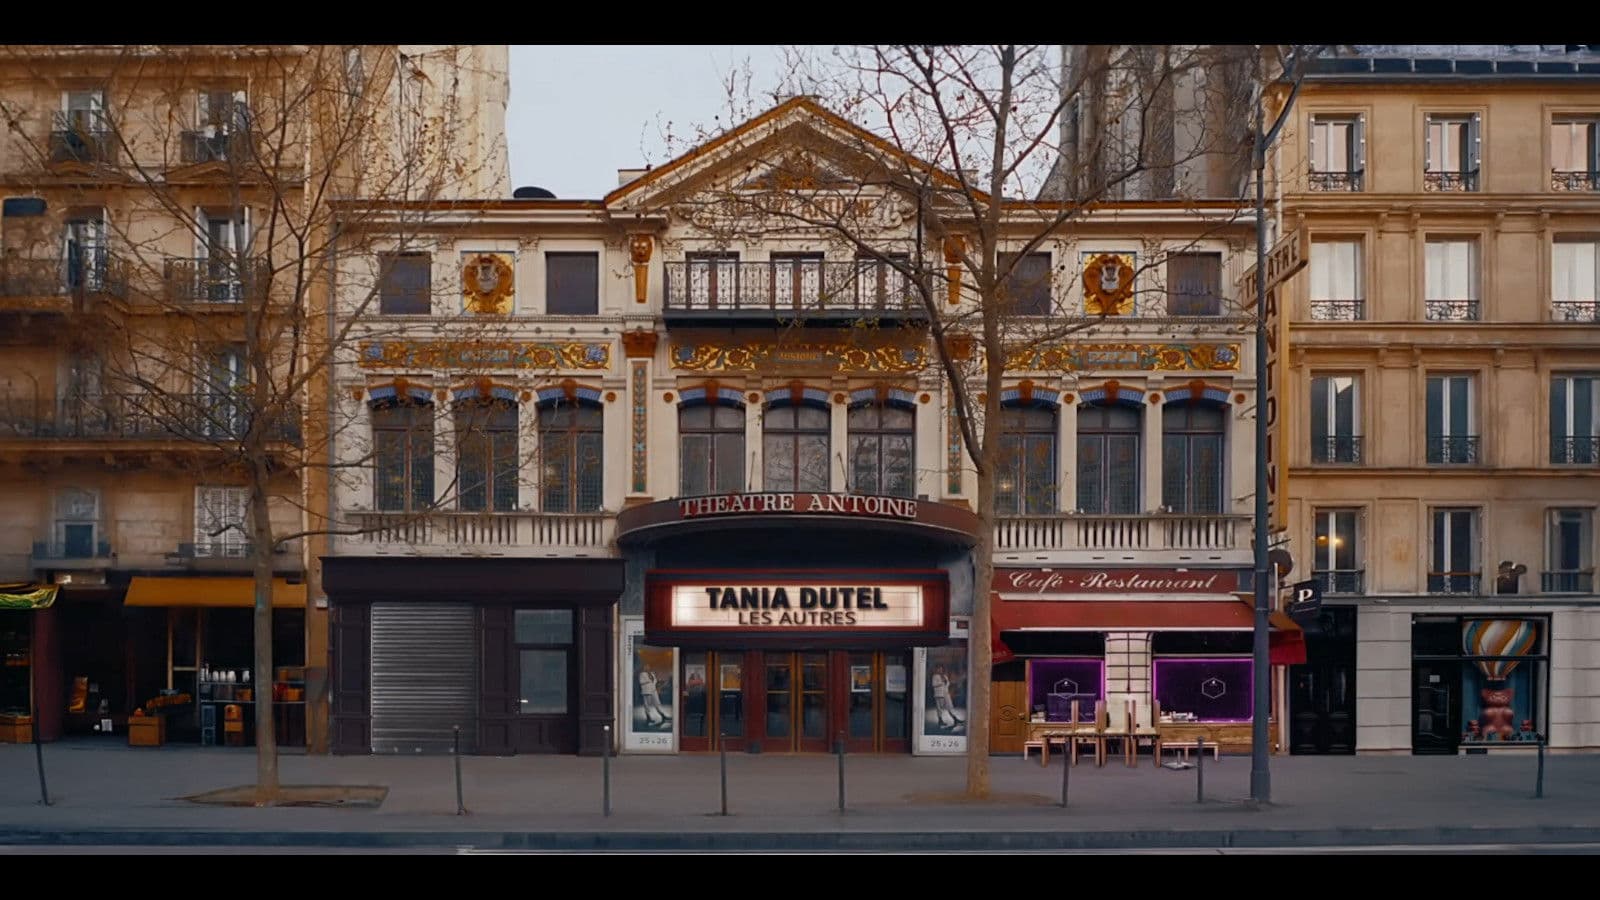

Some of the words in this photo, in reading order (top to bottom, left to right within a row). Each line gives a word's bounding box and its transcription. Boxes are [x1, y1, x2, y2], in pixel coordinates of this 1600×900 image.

[679, 493, 795, 516] THEATRE
[808, 493, 918, 518] ANTOINE
[1009, 571, 1064, 593] Café
[1079, 571, 1218, 590] Restaurant
[706, 587, 791, 609] TANIA
[799, 587, 888, 609] DUTEL
[738, 611, 772, 625] LES
[778, 611, 857, 625] AUTRES
